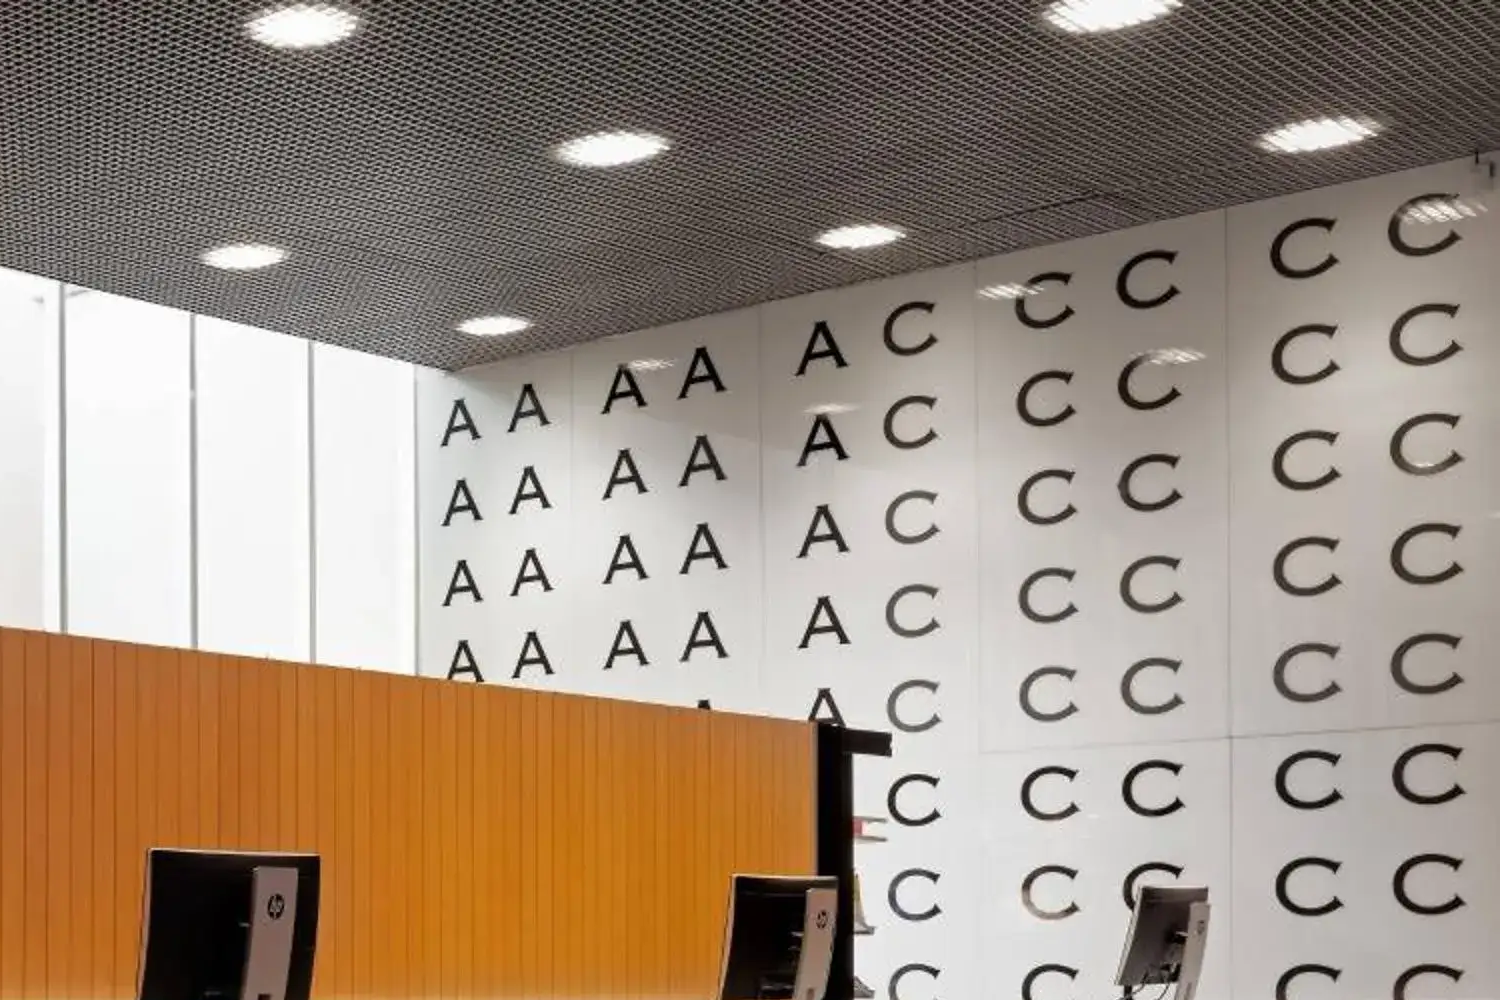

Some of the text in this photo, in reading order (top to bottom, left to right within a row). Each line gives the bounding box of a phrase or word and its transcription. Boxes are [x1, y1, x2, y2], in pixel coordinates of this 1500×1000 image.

[439, 192, 1463, 448] A A A A A C C C C C
[440, 303, 1464, 528] A A A A A C C C C C
[441, 412, 1465, 608] A A A A A C C C C C
[447, 522, 1465, 683] A A A A A C C C C C
[886, 679, 943, 733] C
[1018, 666, 1080, 723] C
[1119, 657, 1186, 716] C
[1272, 642, 1343, 704] C
[1390, 632, 1465, 696] C
[886, 743, 1467, 828] C C C C C
[887, 867, 943, 923] C
[1020, 864, 1081, 921] C
[1274, 856, 1345, 918] C
[1391, 853, 1467, 917] C
